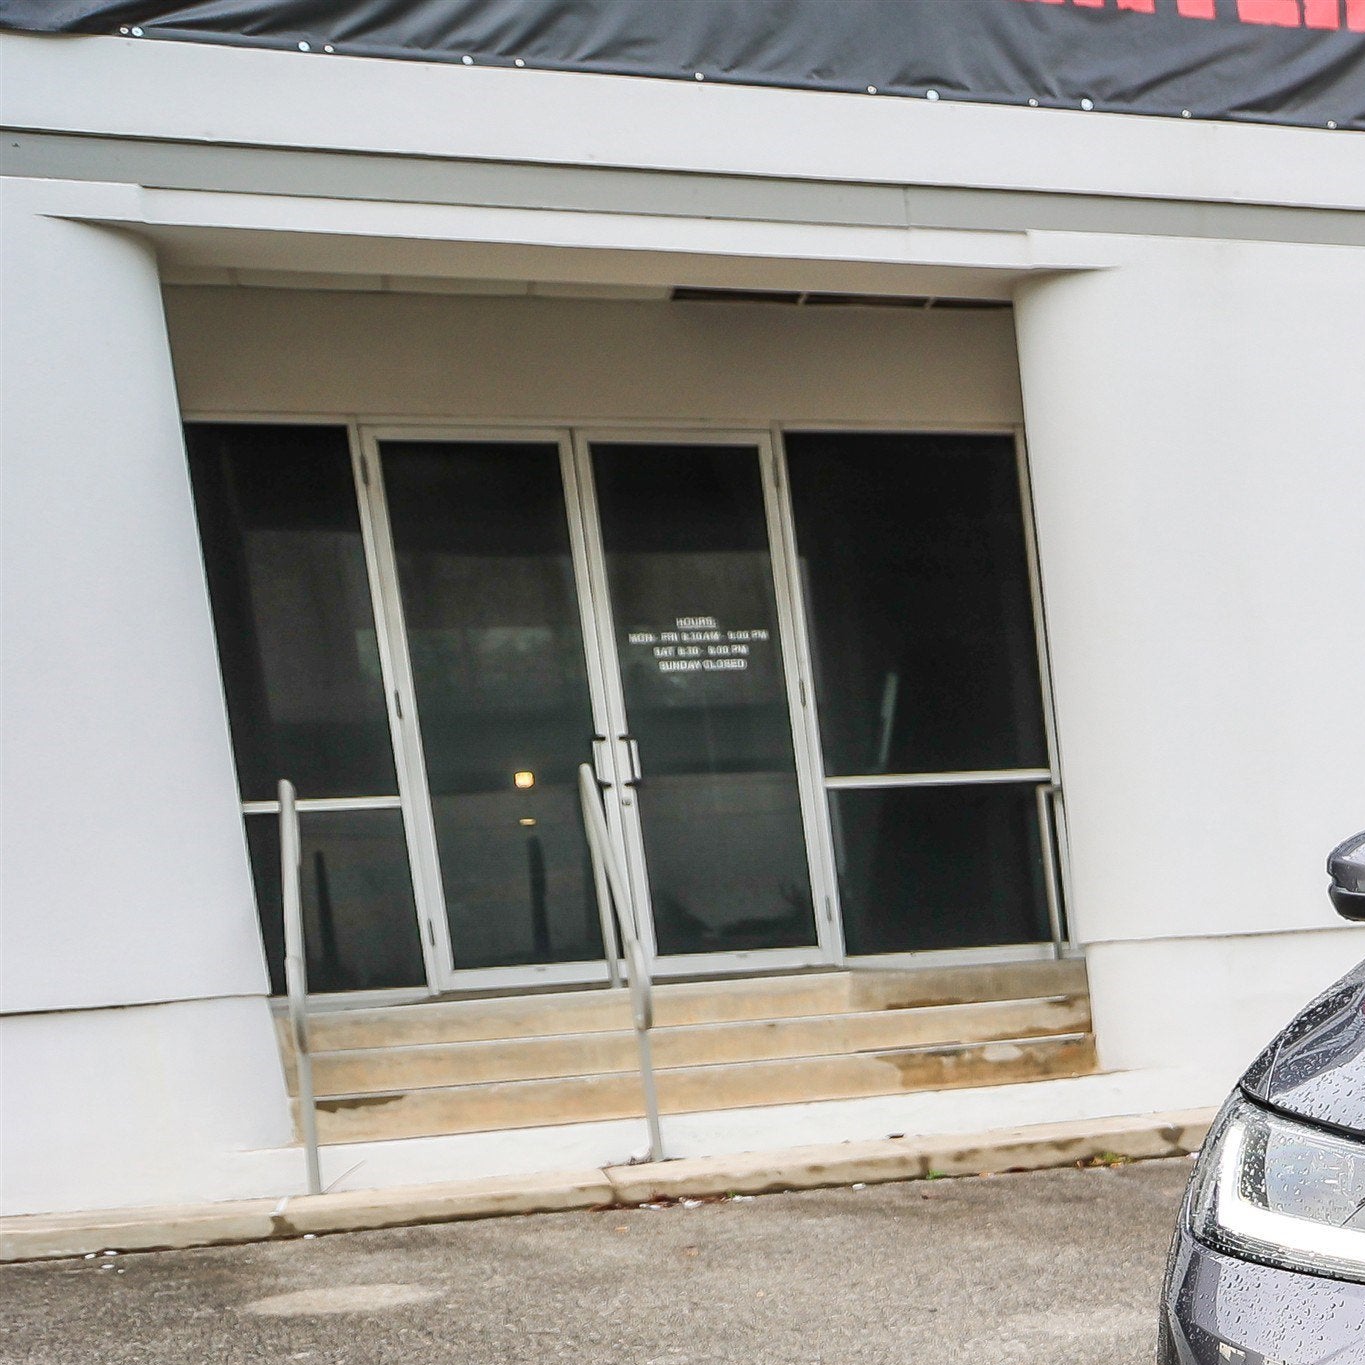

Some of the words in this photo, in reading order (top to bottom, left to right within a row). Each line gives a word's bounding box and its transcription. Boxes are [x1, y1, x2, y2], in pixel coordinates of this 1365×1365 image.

[653, 647, 675, 658] SAT
[659, 661, 702, 672] SUNDAY
[702, 659, 747, 671] CLOSED
